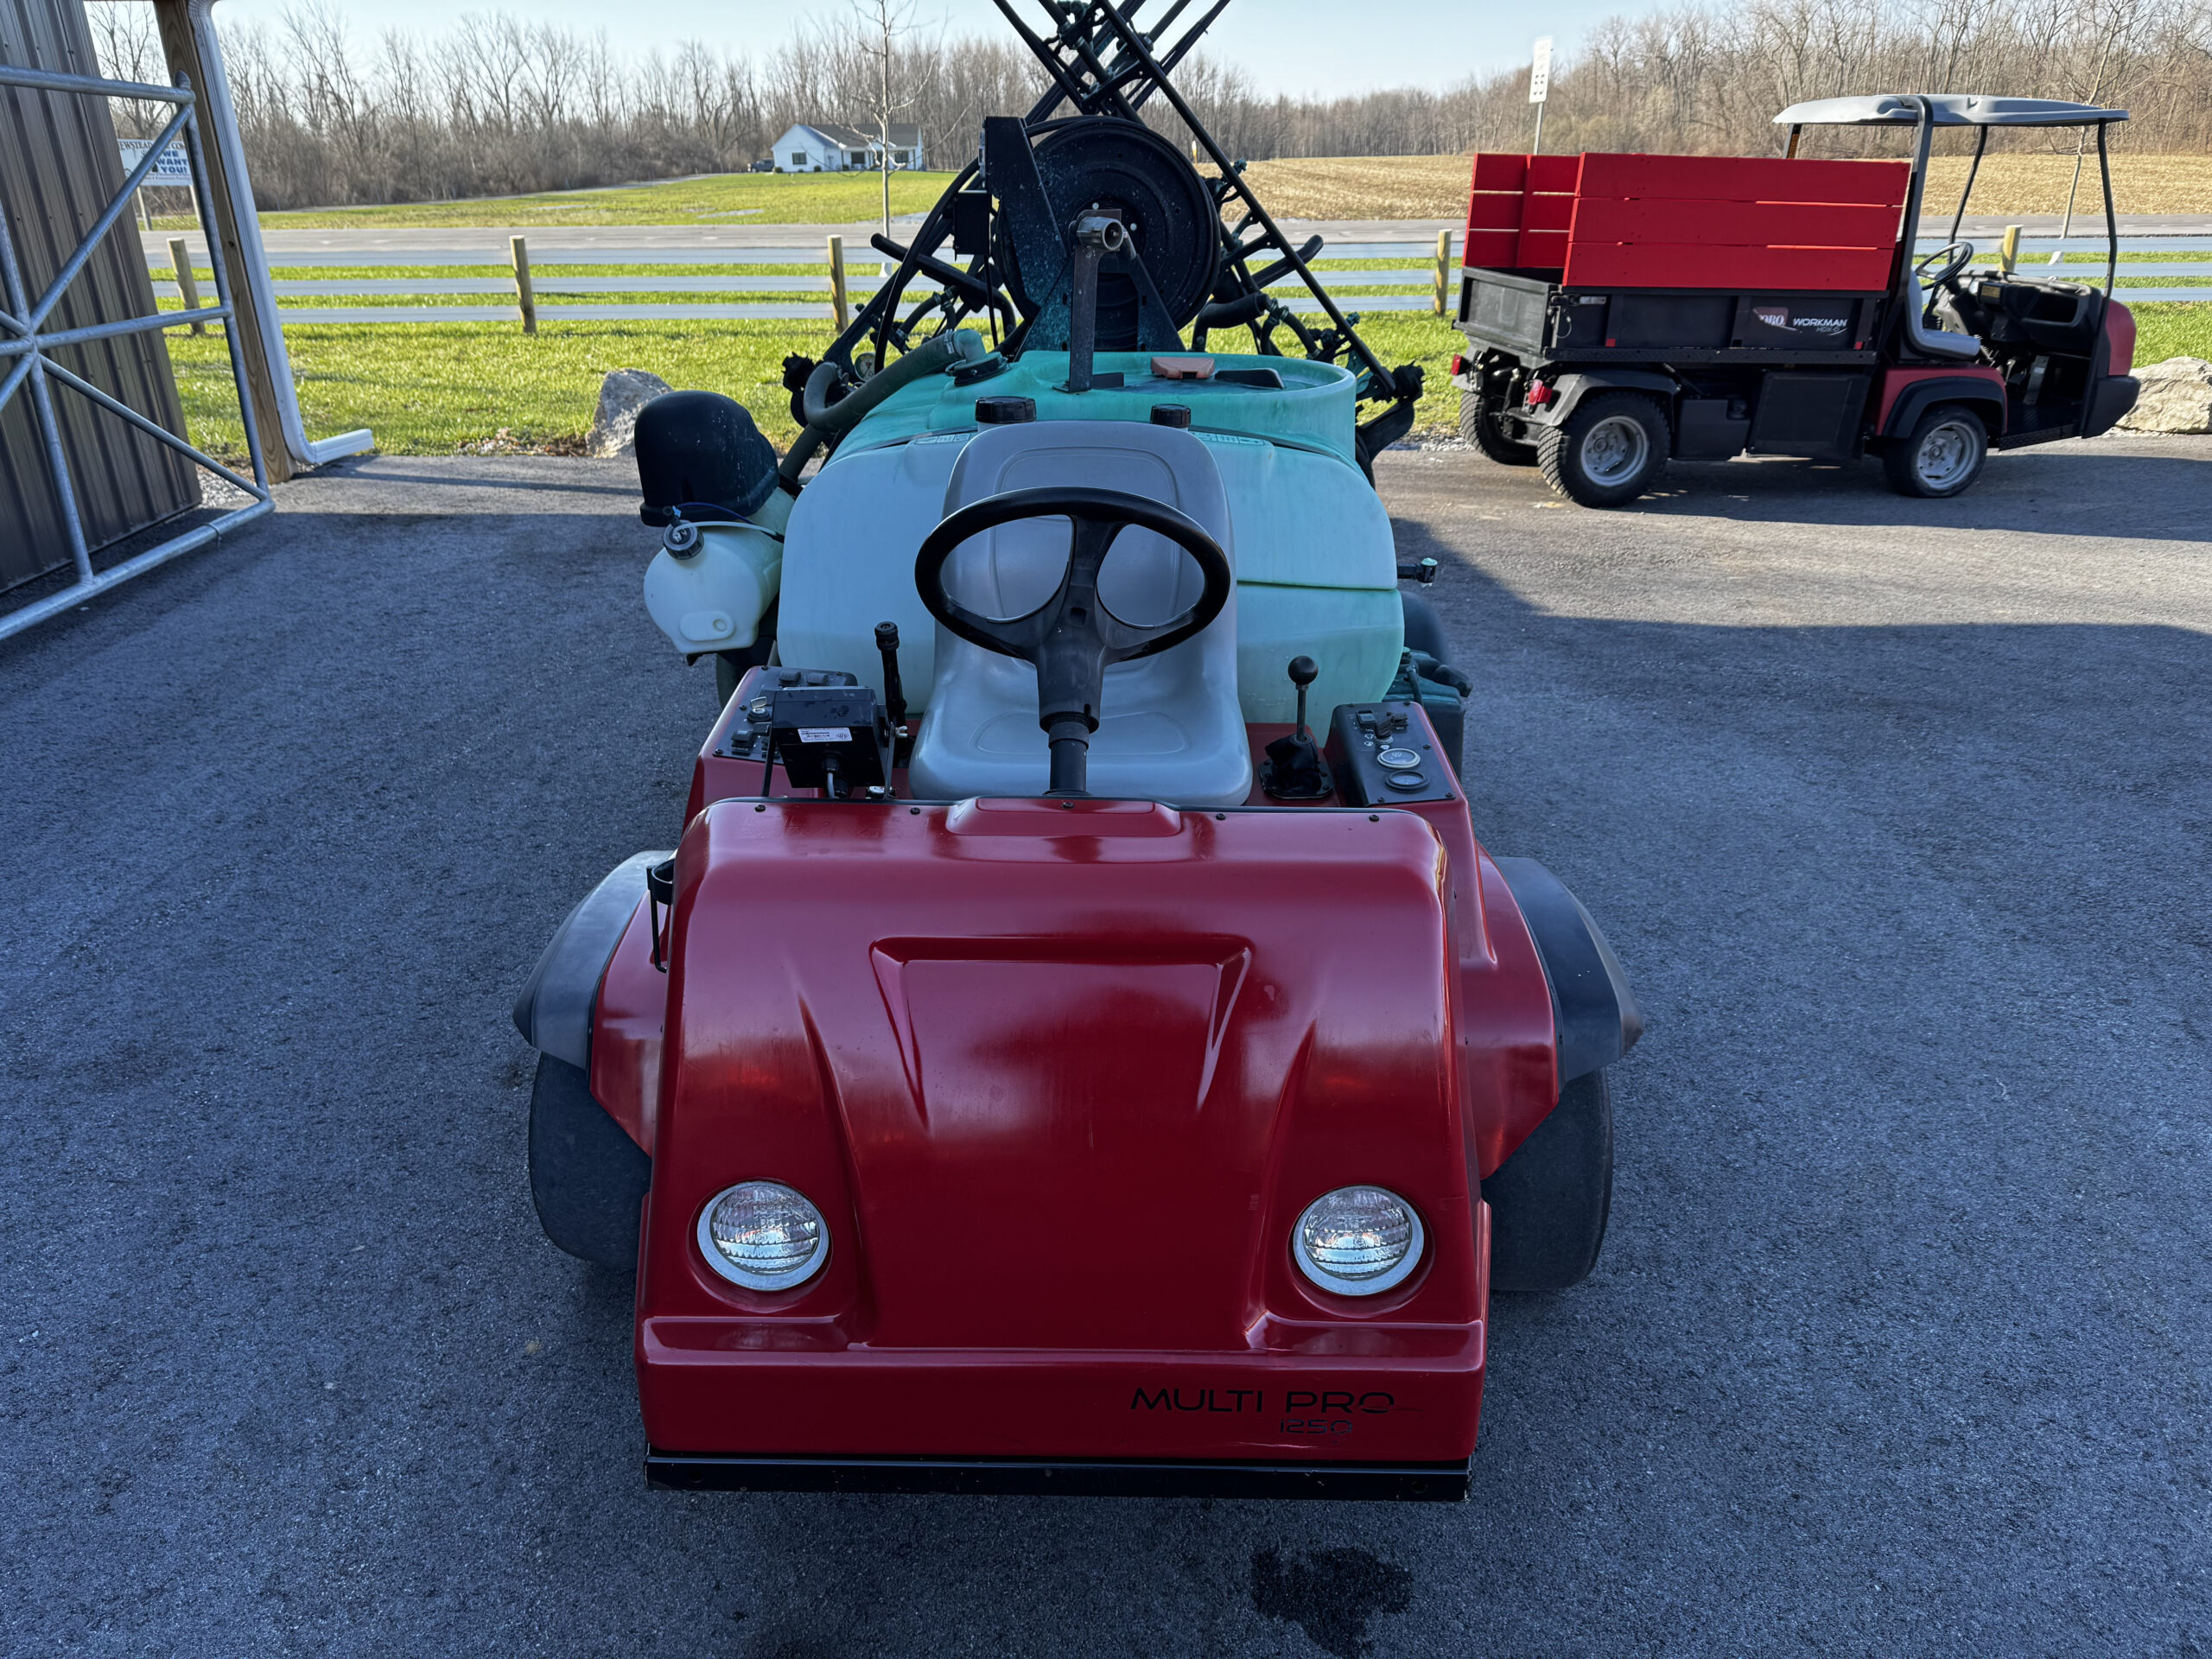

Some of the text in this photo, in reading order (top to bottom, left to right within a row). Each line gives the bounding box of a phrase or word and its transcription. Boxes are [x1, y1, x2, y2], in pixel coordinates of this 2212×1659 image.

[1792, 317, 1848, 327] WORKMAN
[1130, 1387, 1395, 1414] MULTI PRO
